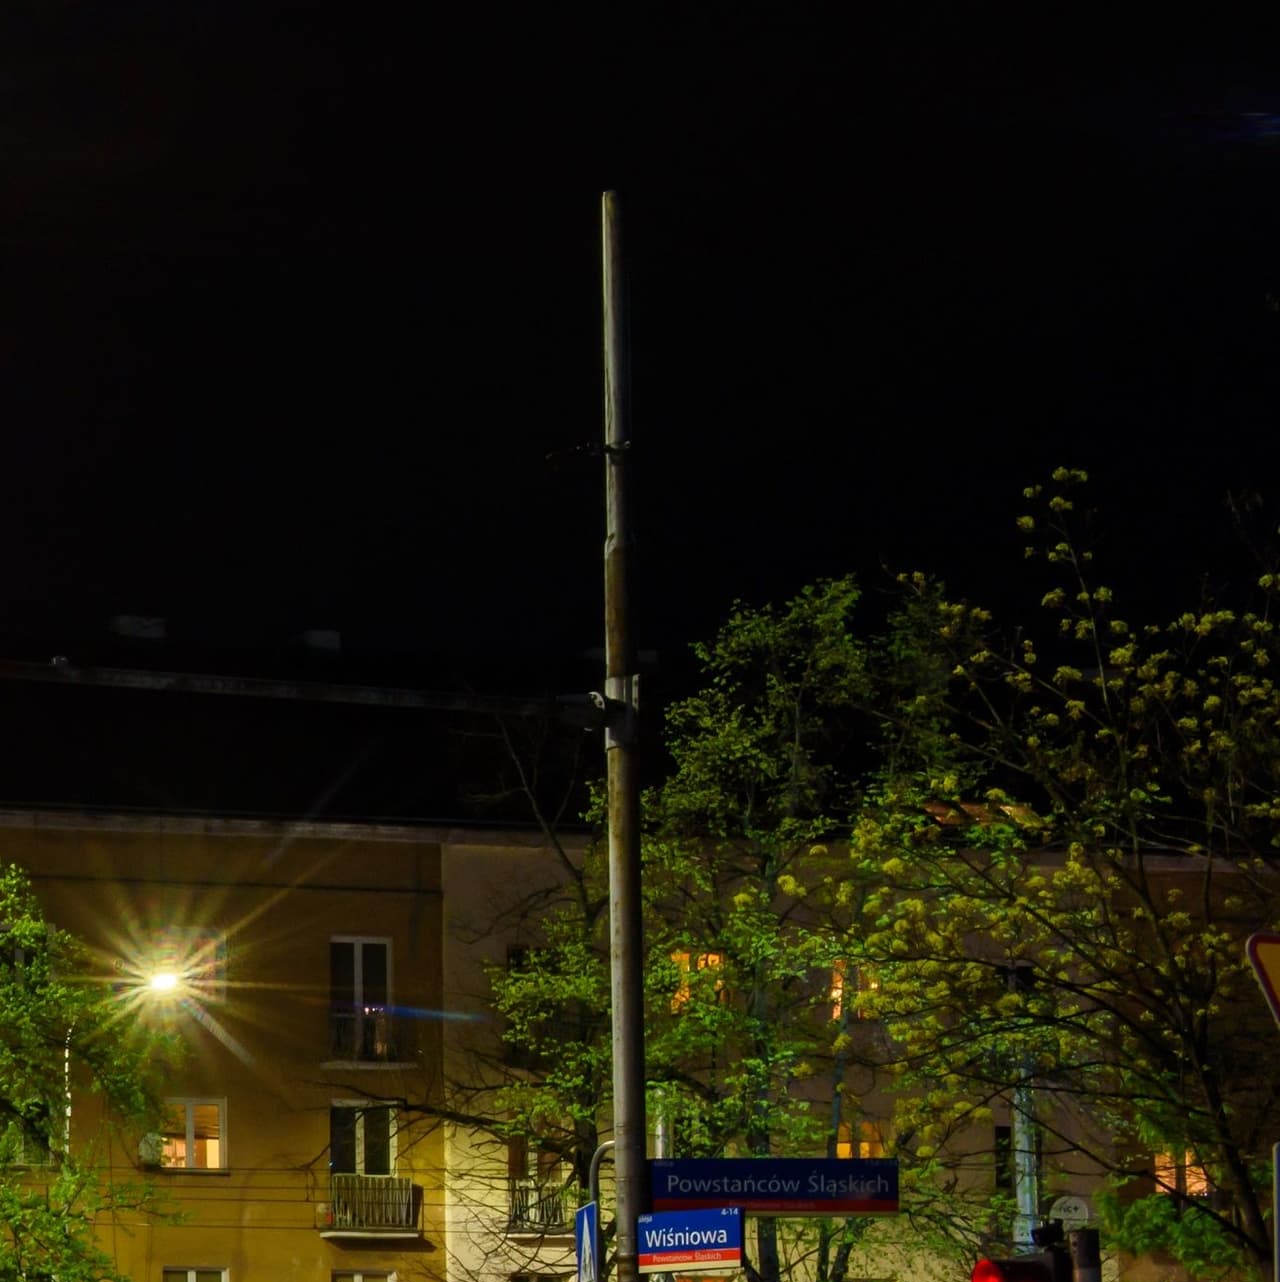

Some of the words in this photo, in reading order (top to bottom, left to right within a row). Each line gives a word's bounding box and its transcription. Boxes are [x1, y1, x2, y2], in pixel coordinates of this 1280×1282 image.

[667, 1172, 801, 1194] Powstańców
[807, 1170, 890, 1196] Śląskich
[721, 1207, 739, 1216] 4-14
[645, 1226, 727, 1249] Wiśniowa
